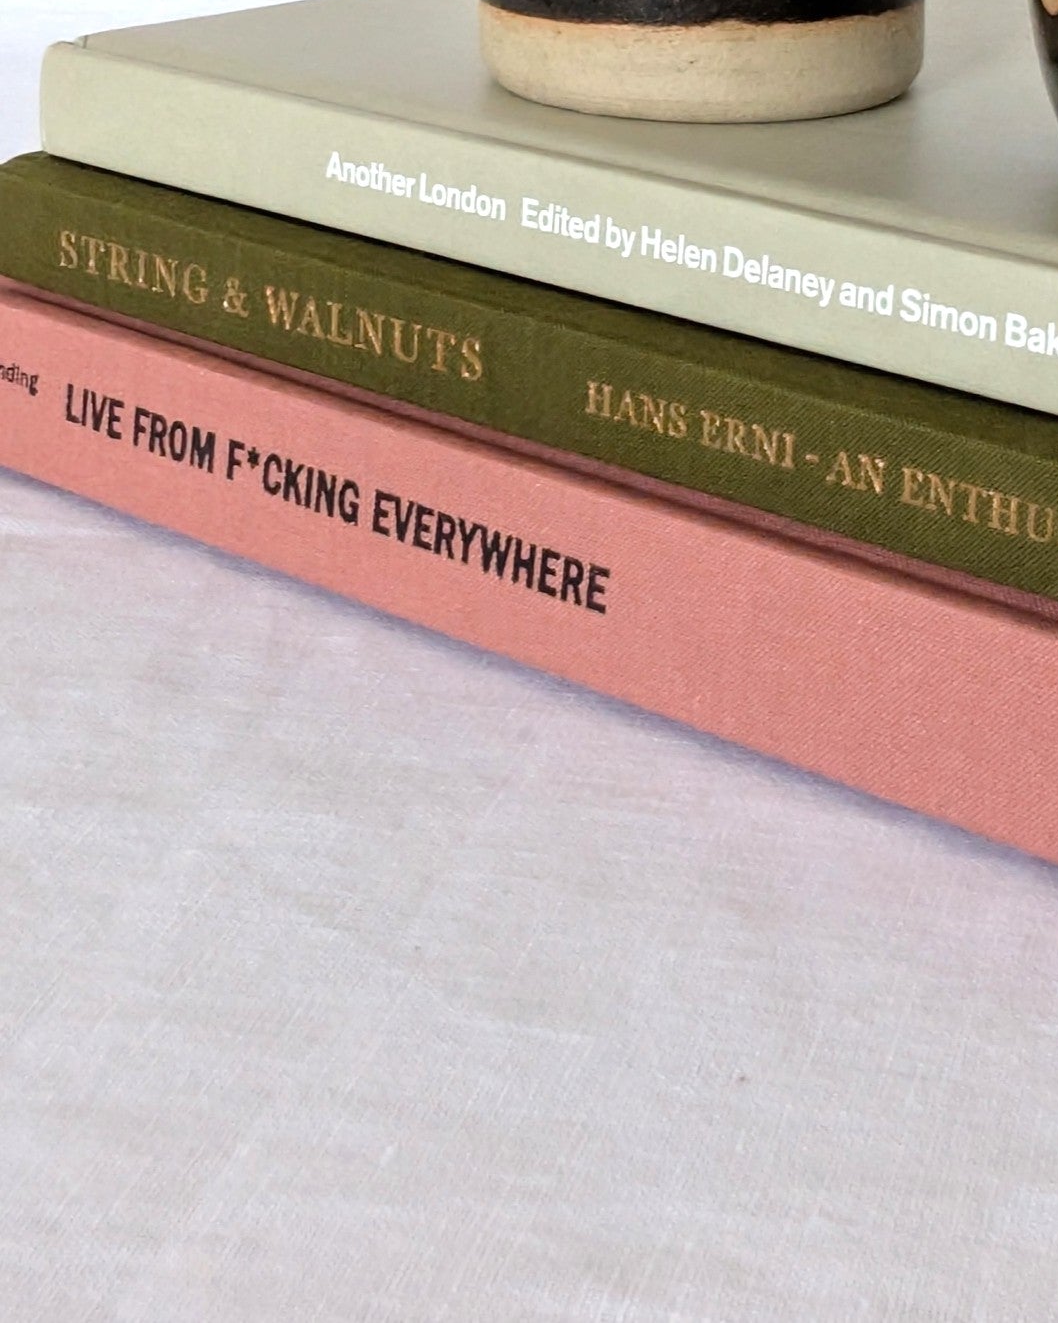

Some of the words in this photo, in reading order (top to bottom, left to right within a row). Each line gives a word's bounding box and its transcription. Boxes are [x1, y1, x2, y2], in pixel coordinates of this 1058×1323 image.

[59, 229, 210, 306] STRING
[222, 276, 249, 319] &
[264, 284, 484, 381] WALNUTS
[325, 151, 416, 198] Another
[419, 173, 507, 221] London
[520, 196, 601, 244] Edited
[605, 217, 636, 258] by
[640, 225, 718, 272] Helen
[722, 245, 835, 308] Delaney
[839, 284, 894, 316] and
[900, 288, 997, 342] Simon
[66, 383, 125, 441] LIVE
[133, 407, 216, 475] FROM
[372, 489, 612, 615] EVERYWHERE
[585, 380, 688, 438] HANS
[700, 409, 795, 470] ERNI
[826, 450, 886, 494] AN
